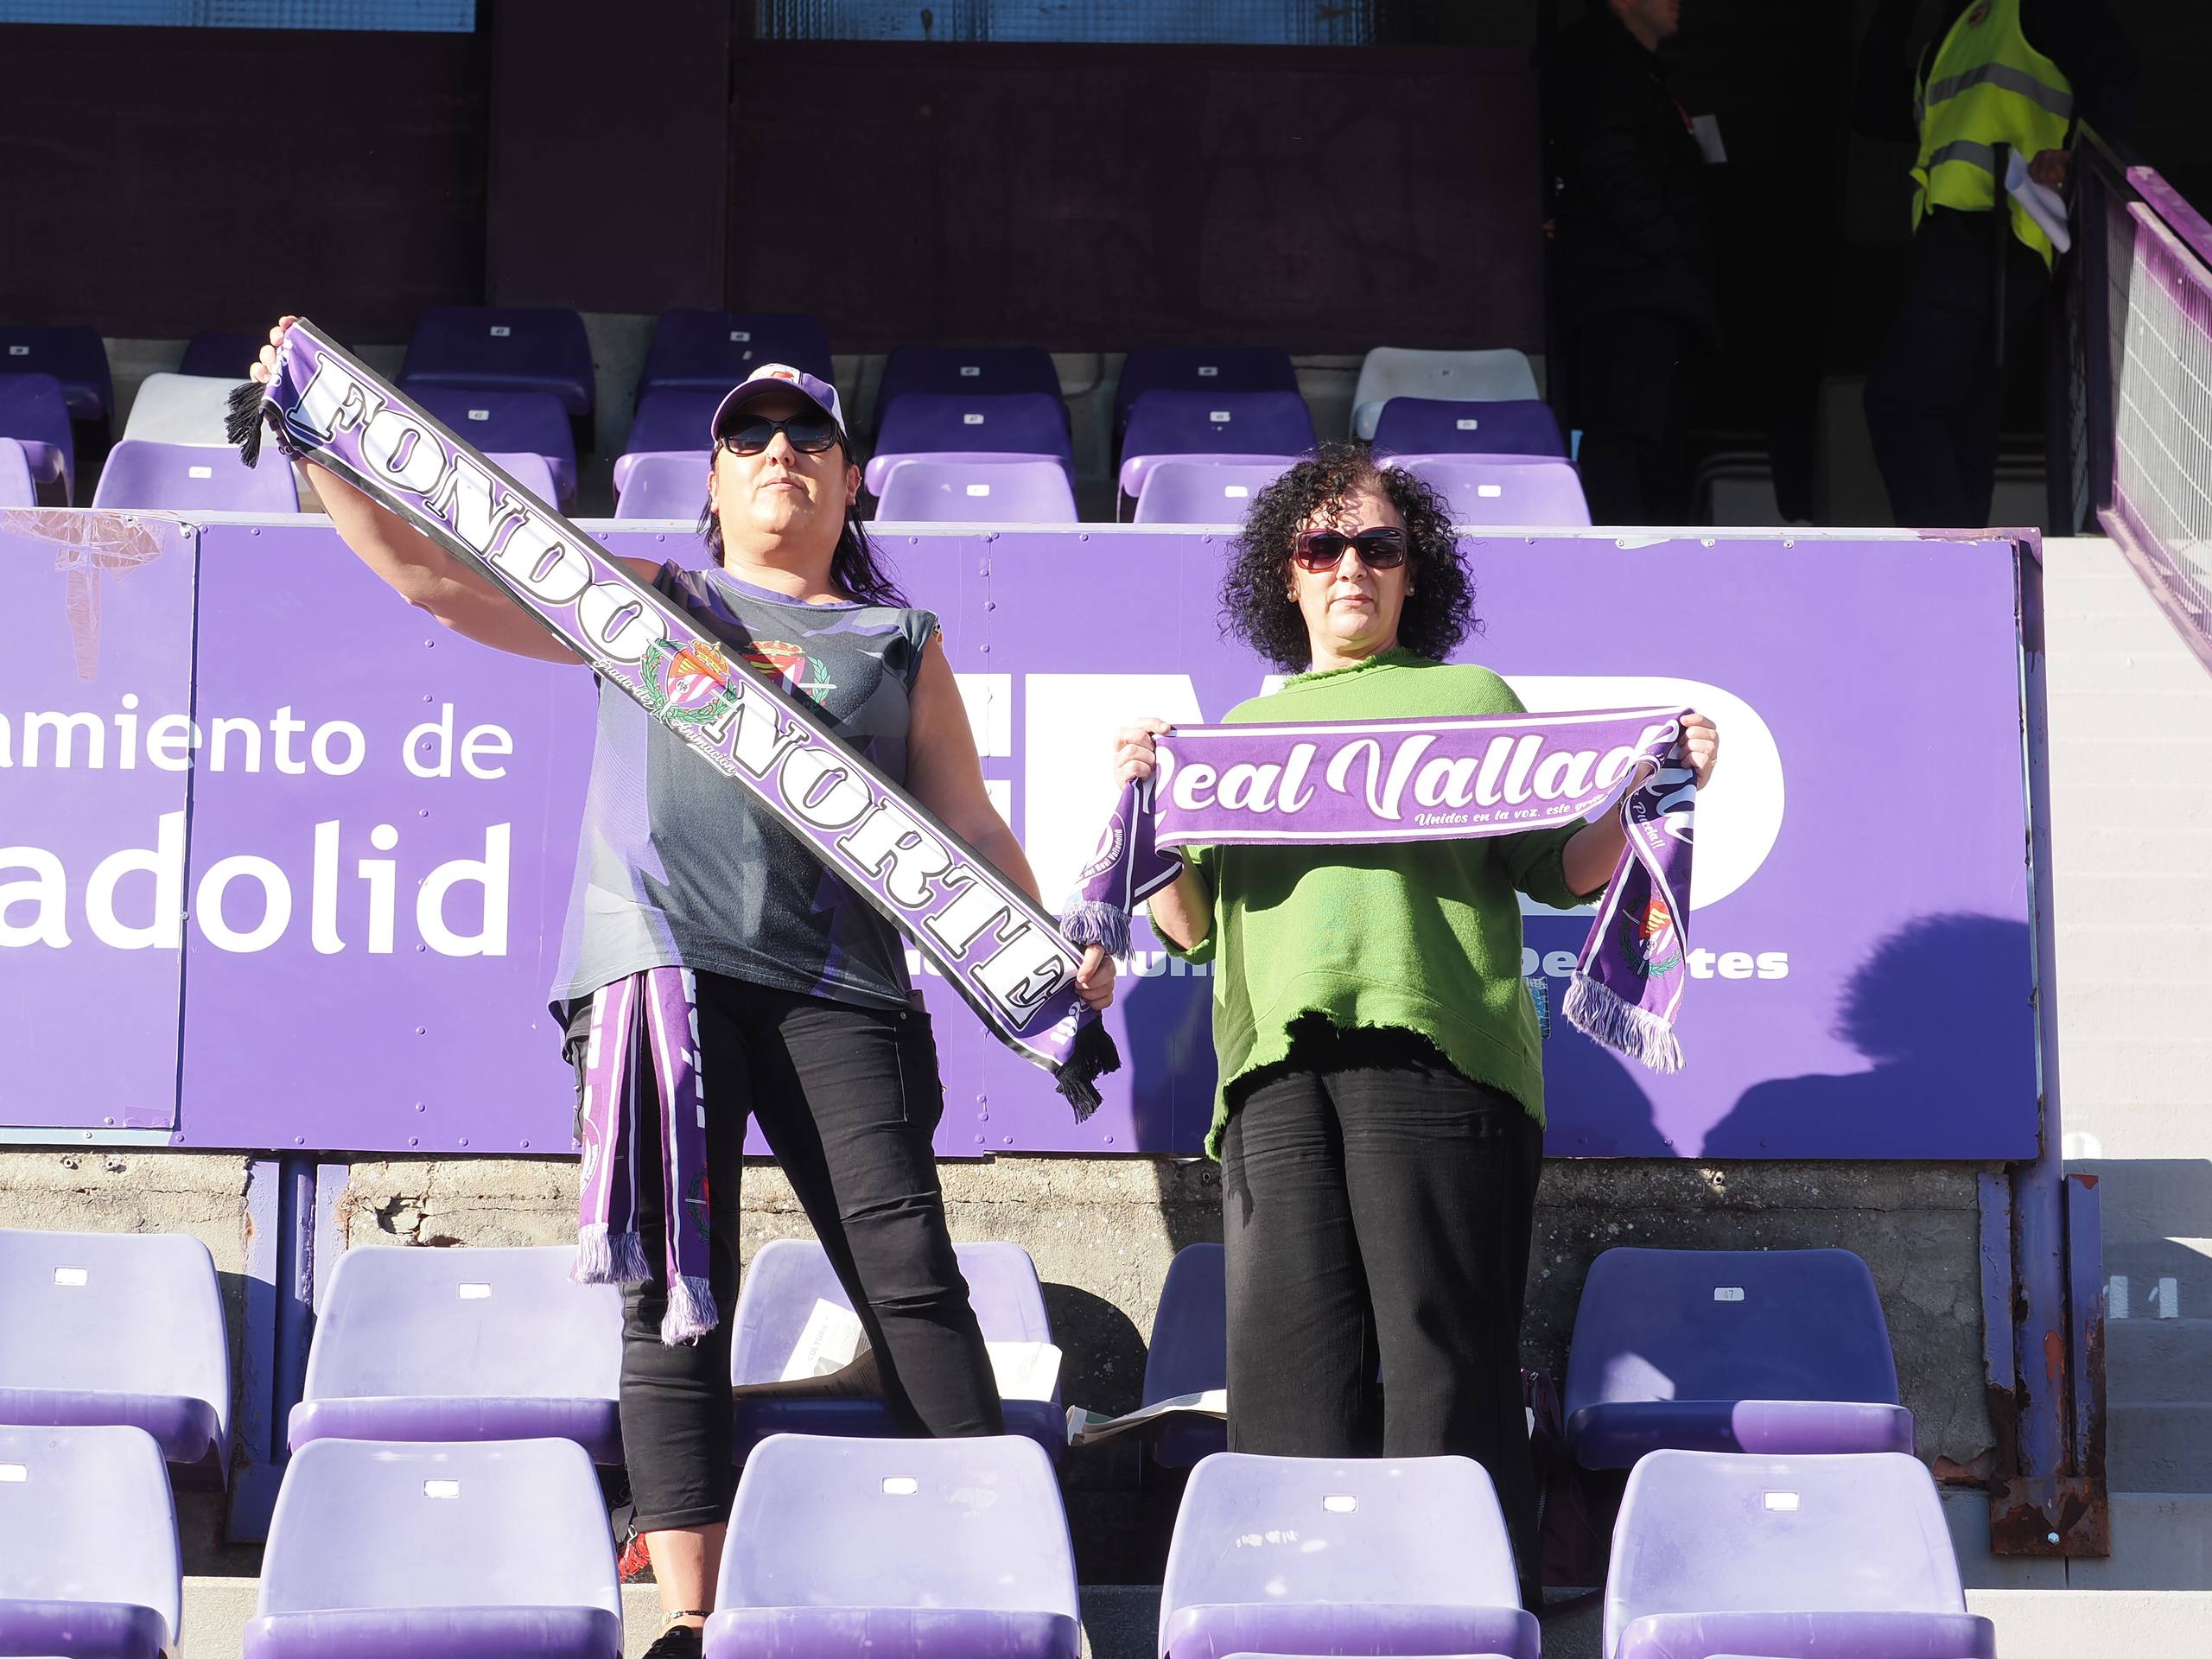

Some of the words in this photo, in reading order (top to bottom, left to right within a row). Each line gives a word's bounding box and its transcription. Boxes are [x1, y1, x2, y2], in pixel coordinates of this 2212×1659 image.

[0, 693, 367, 776] miento
[402, 702, 513, 779] de
[288, 353, 668, 664] FONDO
[700, 681, 1080, 1031] NORTE
[1414, 812, 1469, 827] Unidos
[1472, 813, 1491, 822] en
[1494, 810, 1510, 820] la
[1546, 803, 1571, 816] este
[0, 810, 511, 957] adolid
